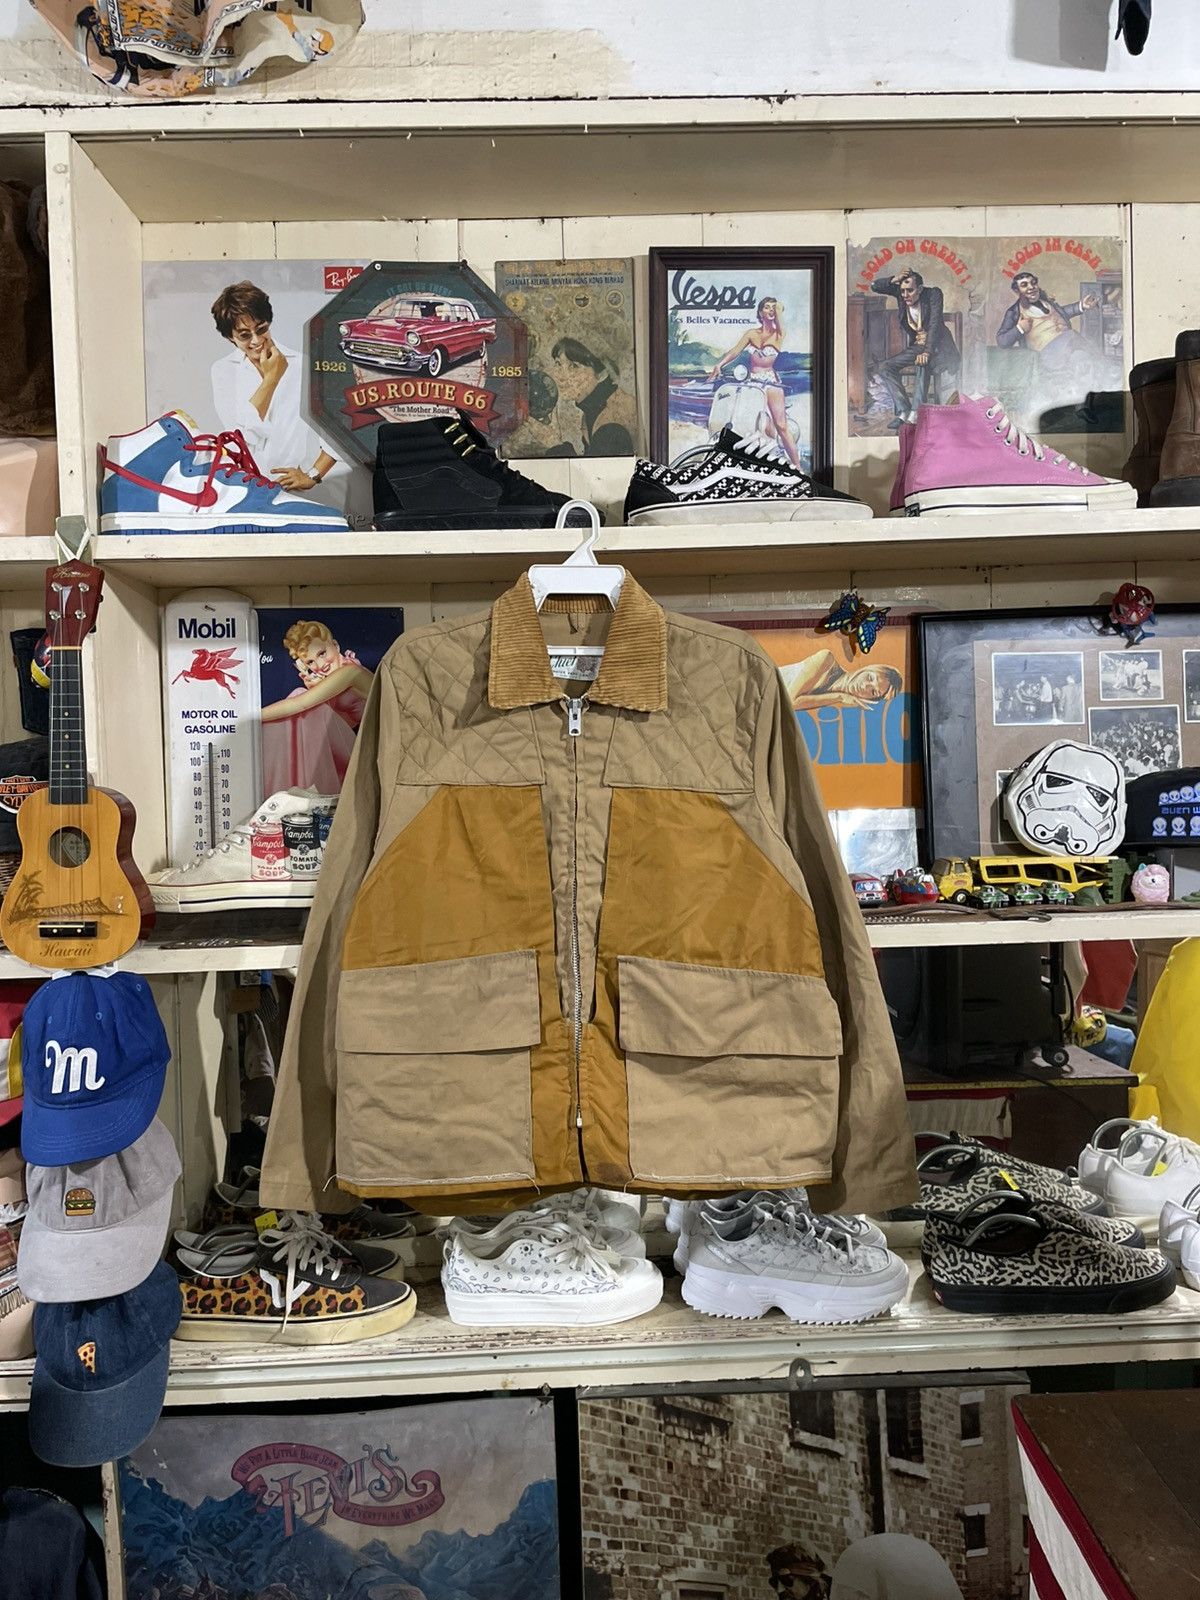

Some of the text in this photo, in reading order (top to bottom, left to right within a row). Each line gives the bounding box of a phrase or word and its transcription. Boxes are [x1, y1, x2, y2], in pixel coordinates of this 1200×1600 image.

[1007, 242, 1042, 272] SOLD
[1045, 238, 1062, 252] IN
[860, 248, 893, 282] SOLD
[895, 239, 916, 255] ON
[670, 270, 757, 311] Vespa
[686, 316, 710, 324] Belles
[314, 360, 347, 373] 1926
[491, 366, 523, 377] 1985
[463, 390, 487, 410] 66
[407, 405, 431, 414] Mother
[178, 618, 236, 639] Mobil
[181, 709, 238, 719] MOTOR OIL
[184, 725, 236, 734] GASOLINE
[190, 741, 201, 751] 120
[220, 749, 231, 758] 110
[190, 757, 201, 766] 100
[220, 764, 230, 774] 90
[193, 772, 202, 781] 80
[221, 779, 229, 789] 70
[193, 787, 202, 796] 60
[221, 794, 230, 803] 50
[193, 801, 203, 810] 40
[222, 808, 231, 817] 30
[194, 815, 203, 824] 20
[222, 821, 230, 830] 10
[292, 862, 318, 871] SOUP
[40, 943, 93, 958] Hawaii
[265, 1450, 272, 1460] A
[272, 1448, 298, 1460] LITTLE
